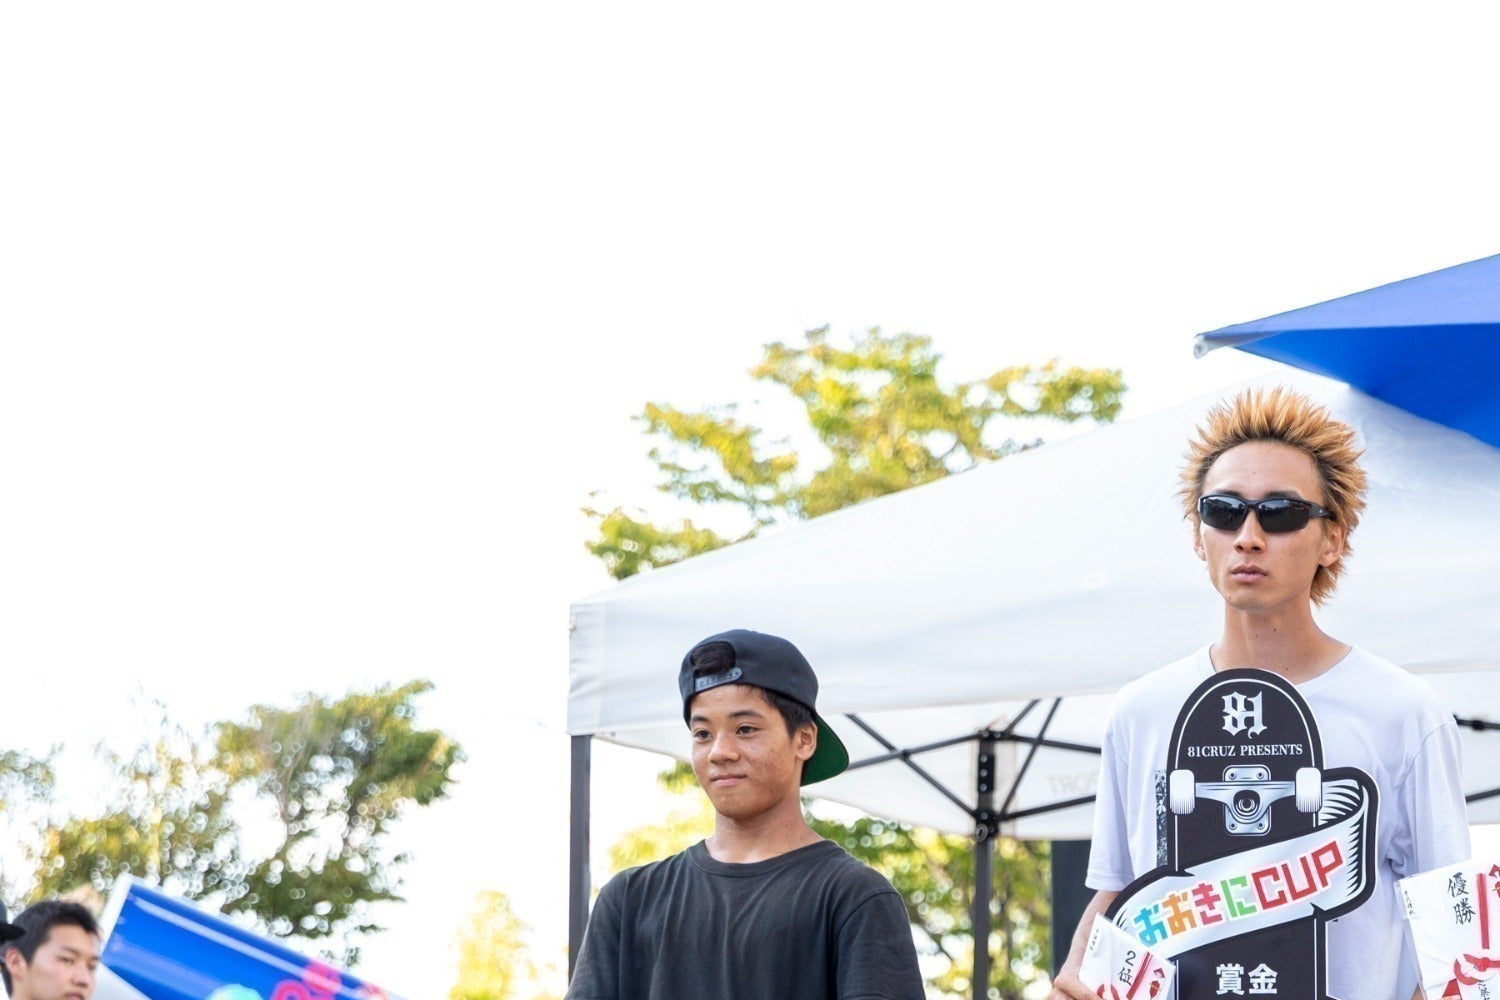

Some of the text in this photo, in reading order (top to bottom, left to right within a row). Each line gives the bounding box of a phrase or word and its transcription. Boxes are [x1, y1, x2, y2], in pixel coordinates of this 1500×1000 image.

[1187, 743, 1304, 758] 81CRUZ PRESENTS
[1132, 839, 1346, 948] おおきにCUP
[1447, 871, 1476, 926] 優勝
[1215, 963, 1279, 996] 賞金
